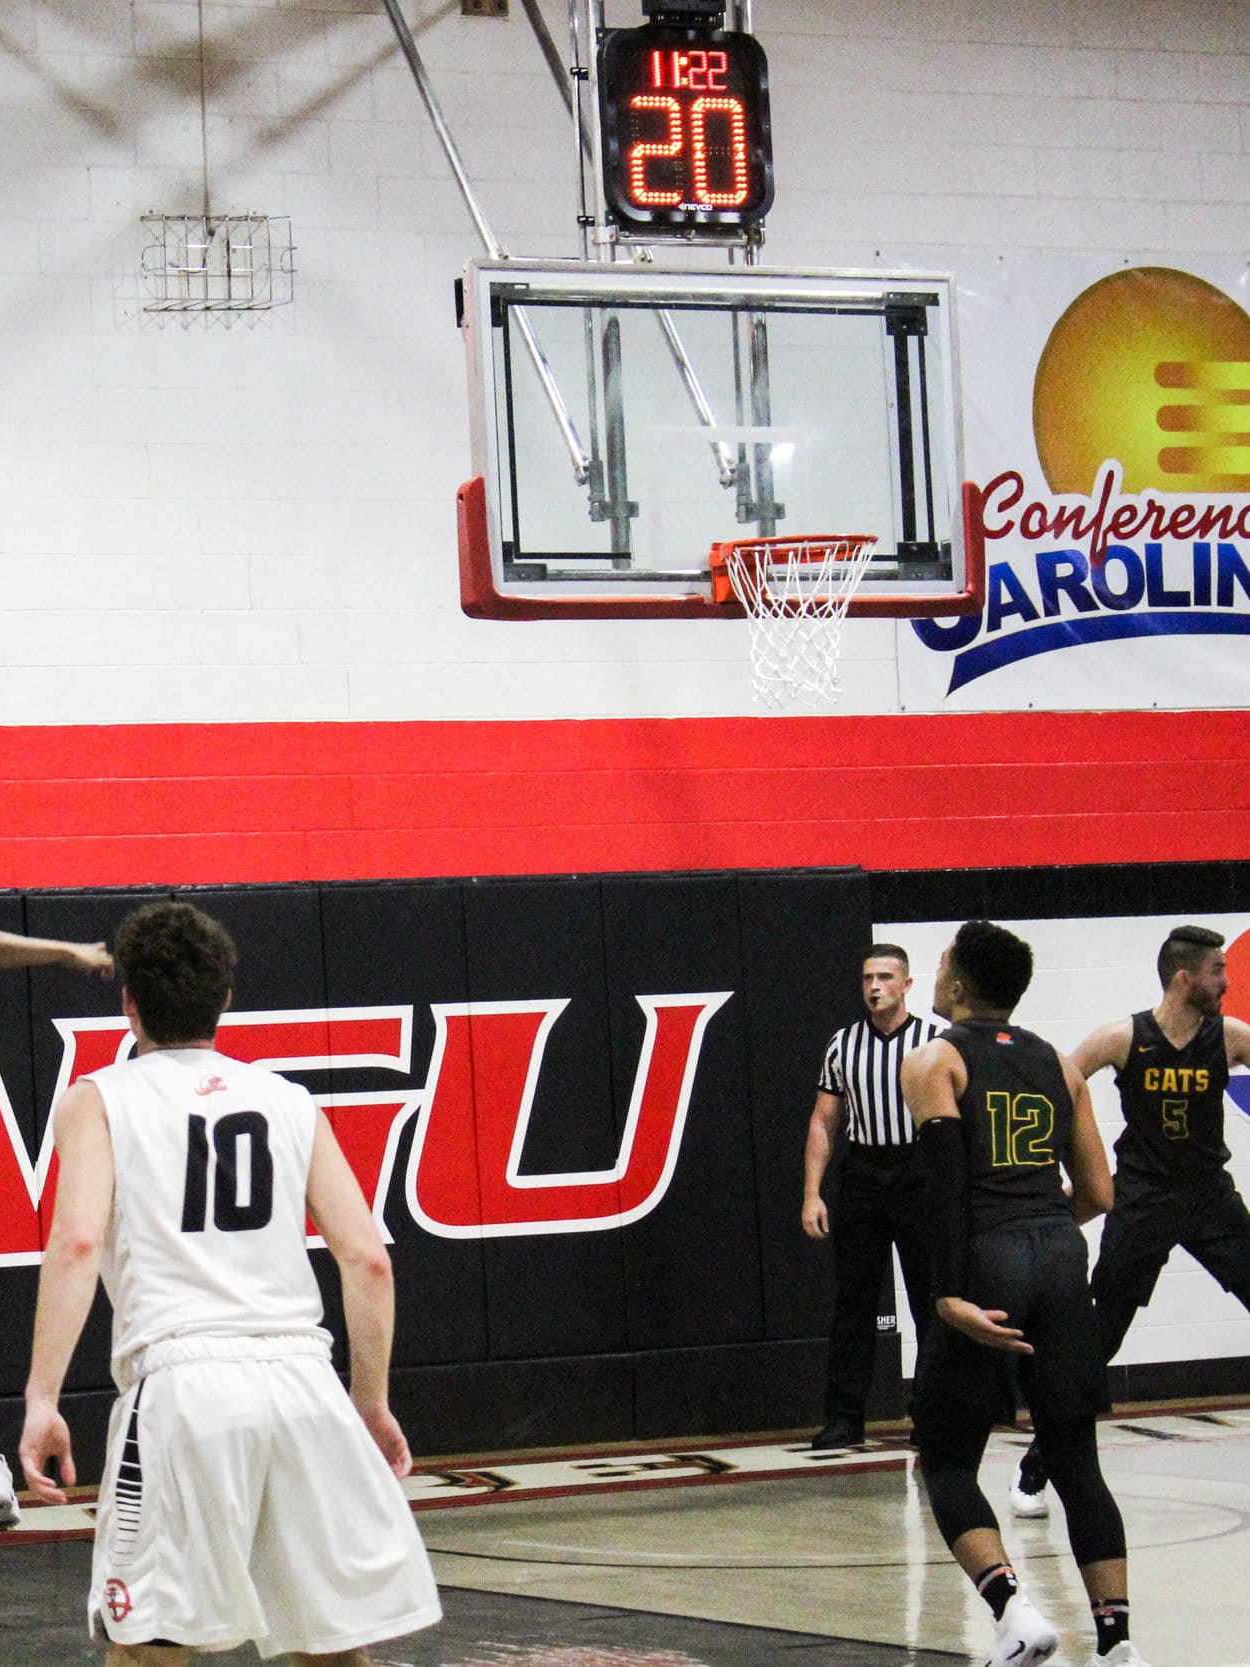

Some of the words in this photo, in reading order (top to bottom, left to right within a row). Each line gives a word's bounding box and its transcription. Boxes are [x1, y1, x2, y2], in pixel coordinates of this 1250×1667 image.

[652, 51, 728, 89] 11:22
[631, 96, 747, 204] 20
[1144, 1067, 1210, 1092] CATS
[986, 1091, 1055, 1166] 12
[1162, 1099, 1189, 1139] 5
[180, 1111, 273, 1232] 10
